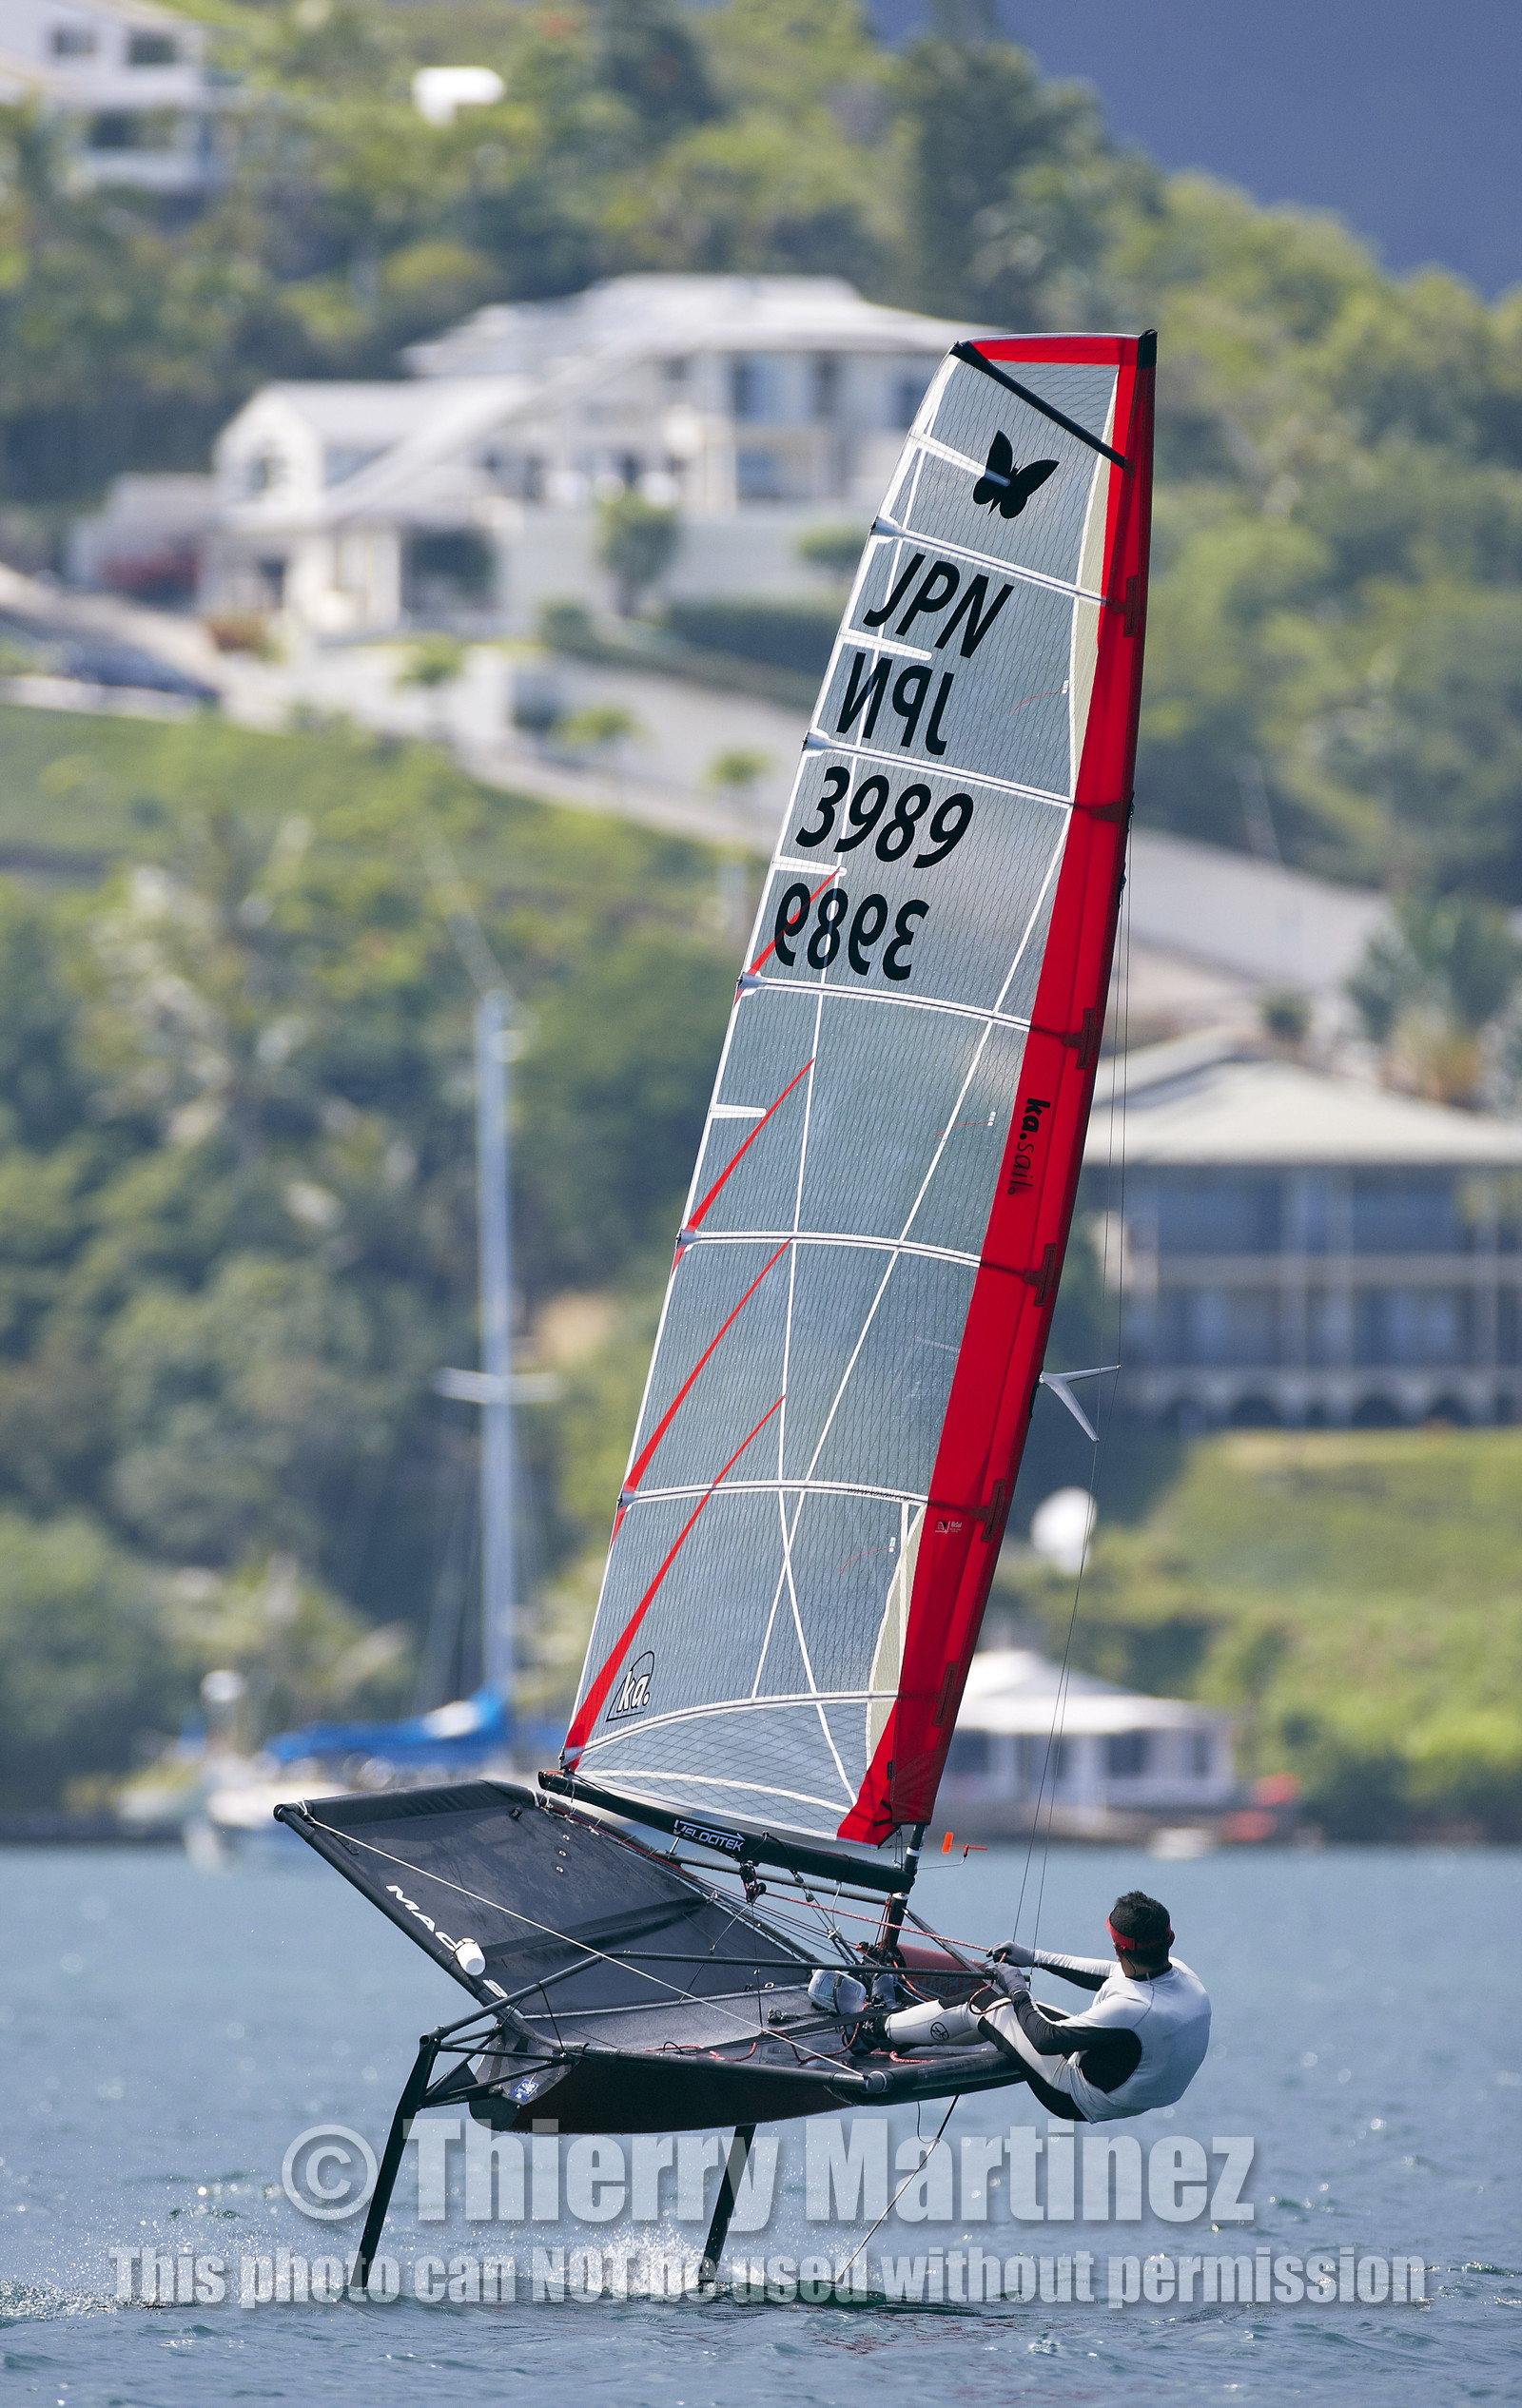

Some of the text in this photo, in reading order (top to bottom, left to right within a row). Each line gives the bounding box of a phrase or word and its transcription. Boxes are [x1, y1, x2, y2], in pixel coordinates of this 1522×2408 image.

[863, 553, 1014, 658] JPN
[795, 767, 974, 869] 3989
[673, 1819, 744, 1852] VELOCITEK
[385, 1885, 459, 1952] MAC
